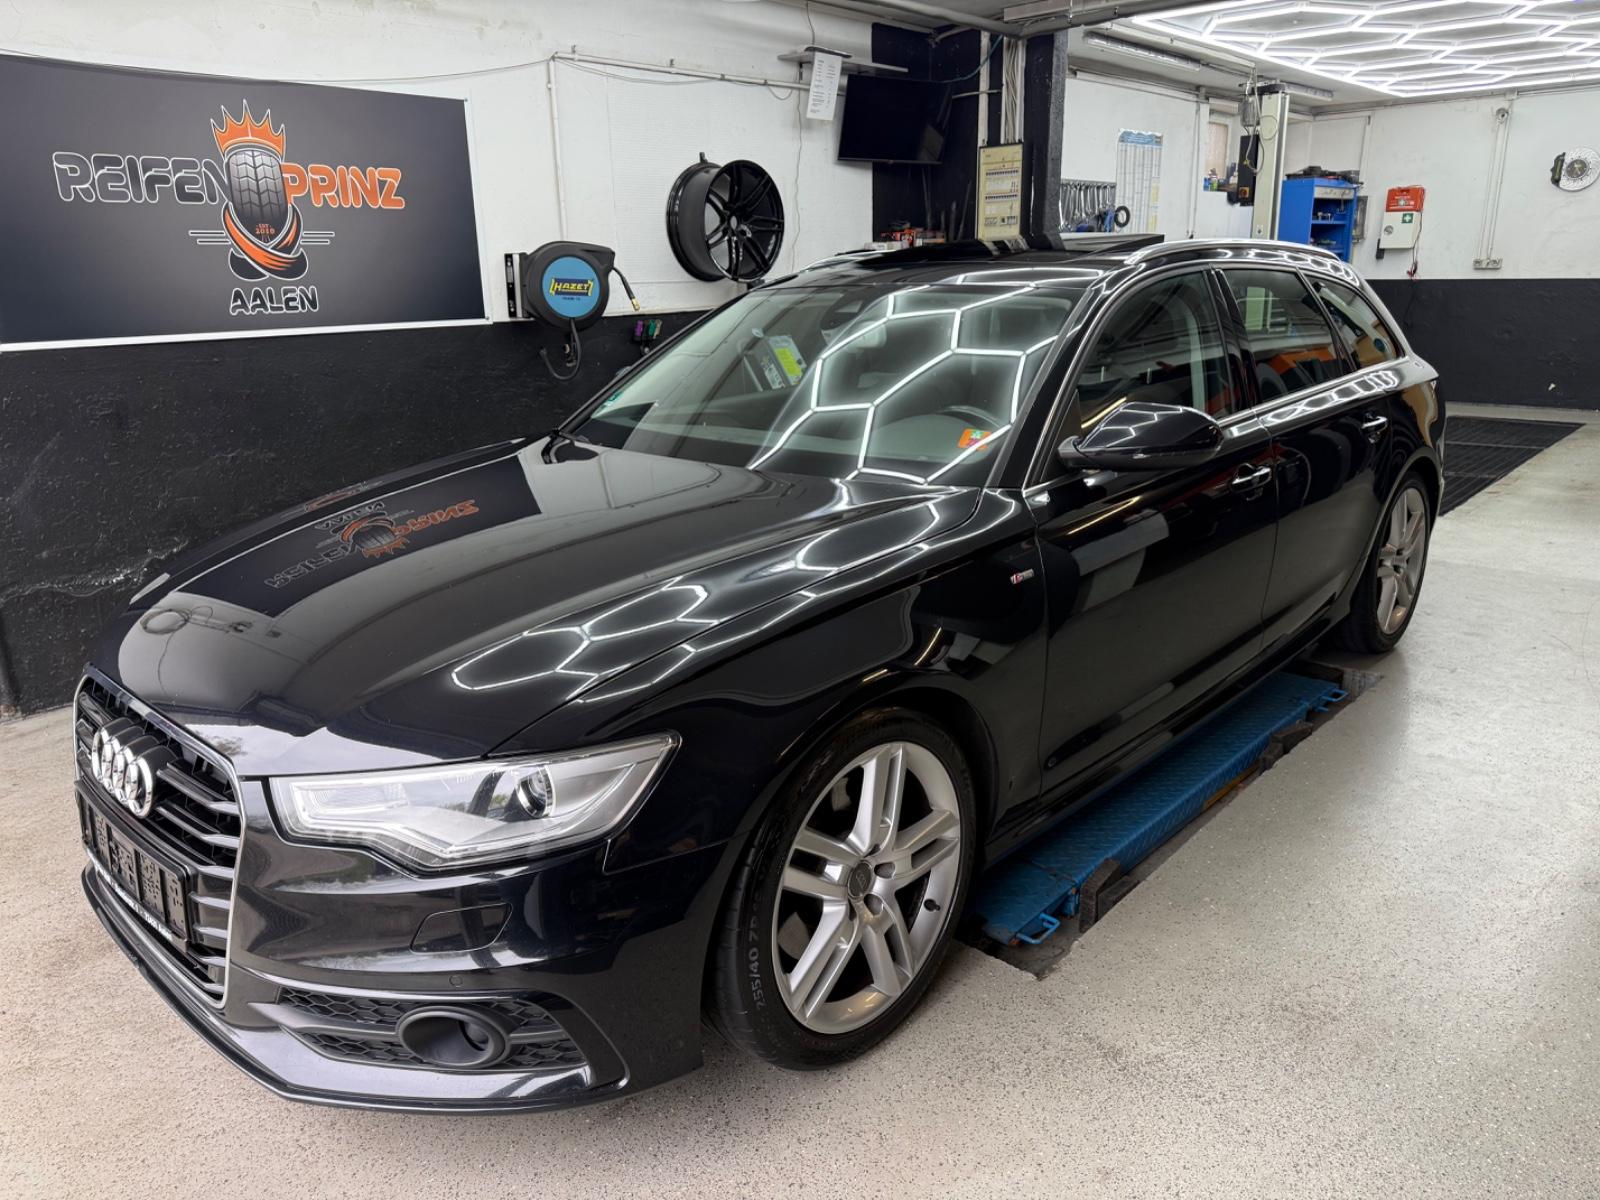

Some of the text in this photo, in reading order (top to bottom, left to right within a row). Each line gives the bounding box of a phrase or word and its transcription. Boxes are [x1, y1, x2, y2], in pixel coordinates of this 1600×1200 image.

[52, 151, 405, 209] REIFEN PRINZ
[229, 285, 319, 316] AALEN
[552, 280, 590, 293] HAZET
[748, 946, 767, 1011] 255/40
